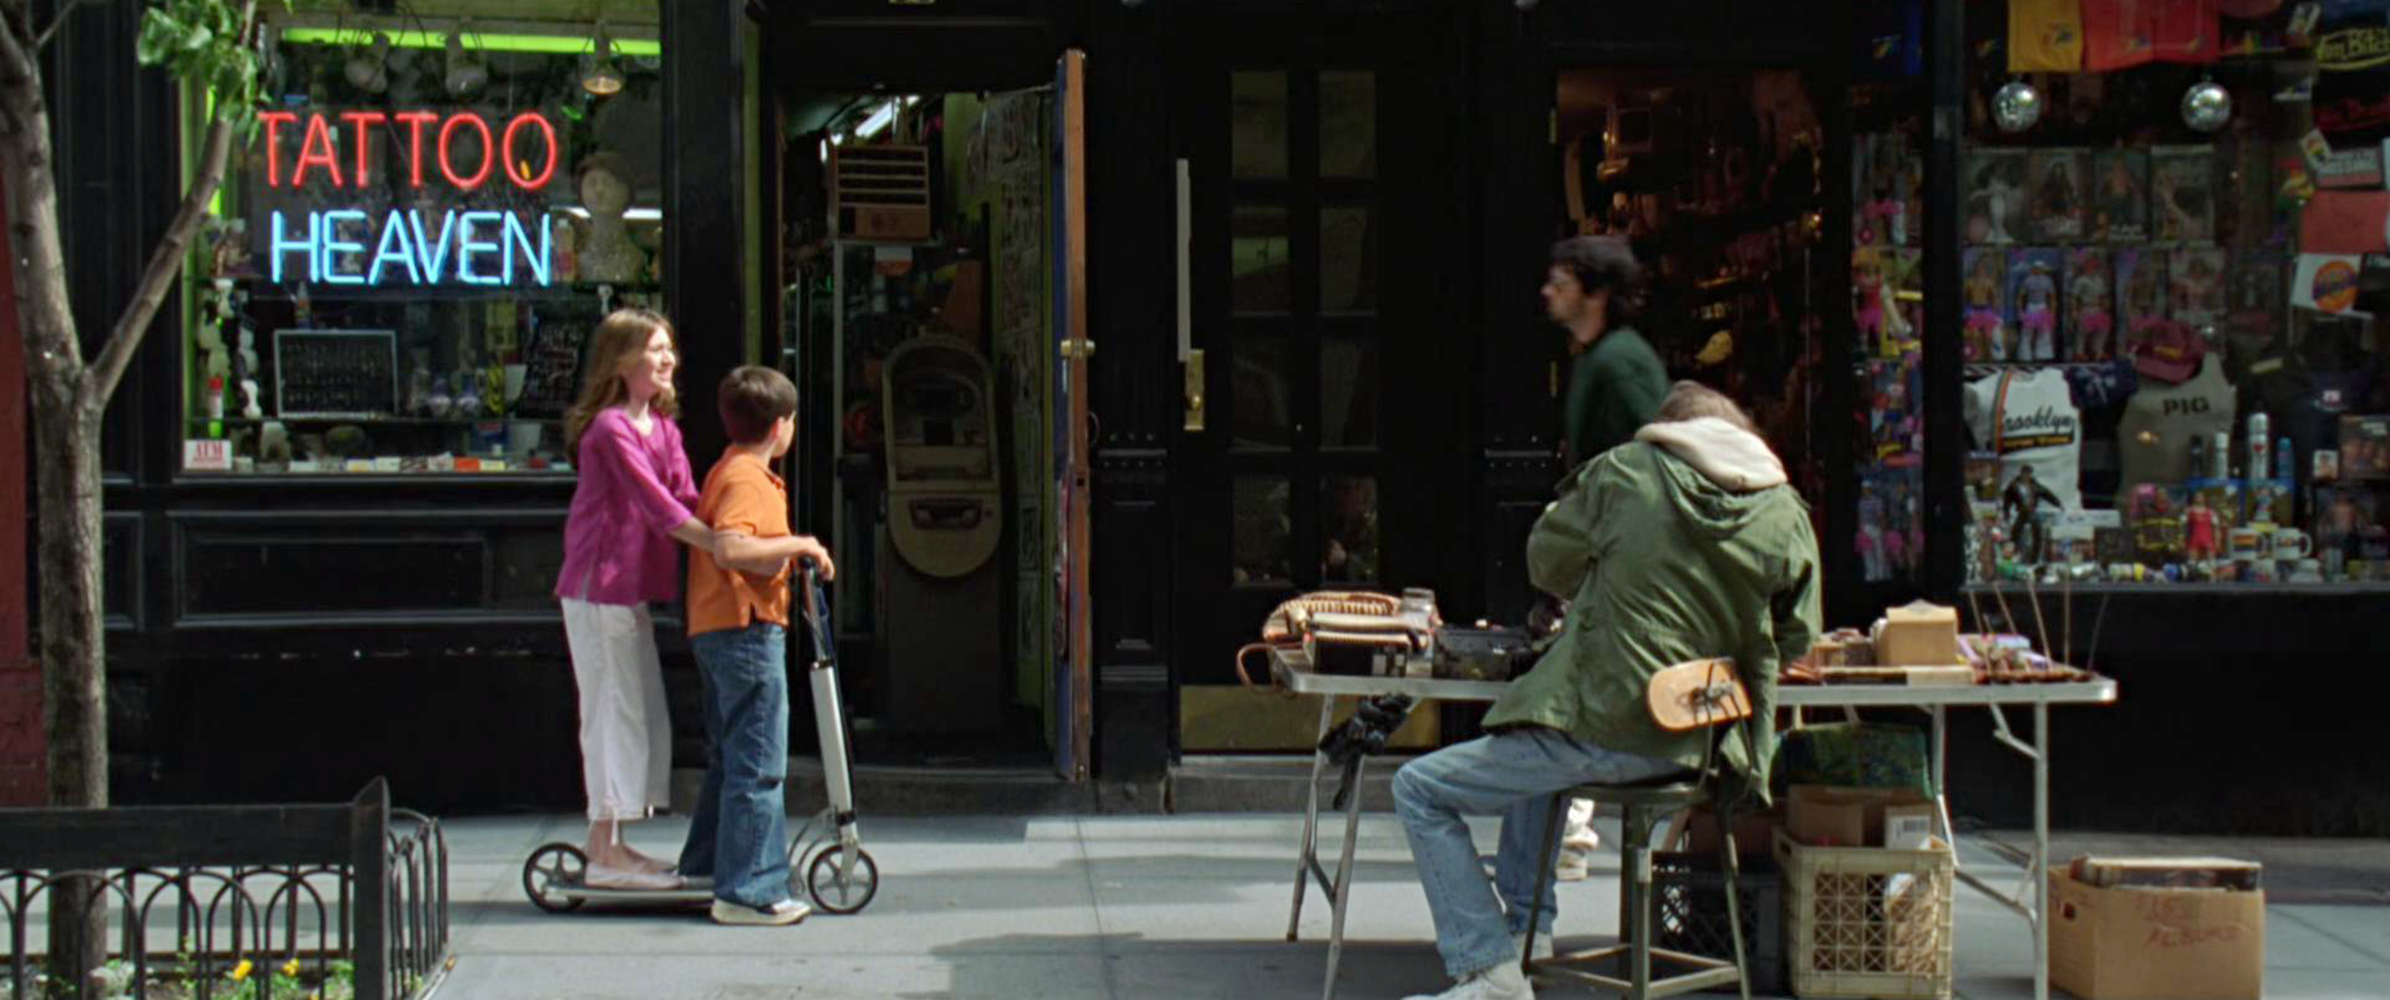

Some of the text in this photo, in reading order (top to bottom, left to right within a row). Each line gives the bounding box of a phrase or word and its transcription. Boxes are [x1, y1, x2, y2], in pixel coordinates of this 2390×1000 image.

[258, 112, 557, 190] TATTOO
[270, 209, 551, 286] HEAVEN
[2004, 405, 2075, 433] rooklyn
[2163, 397, 2210, 416] PIG
